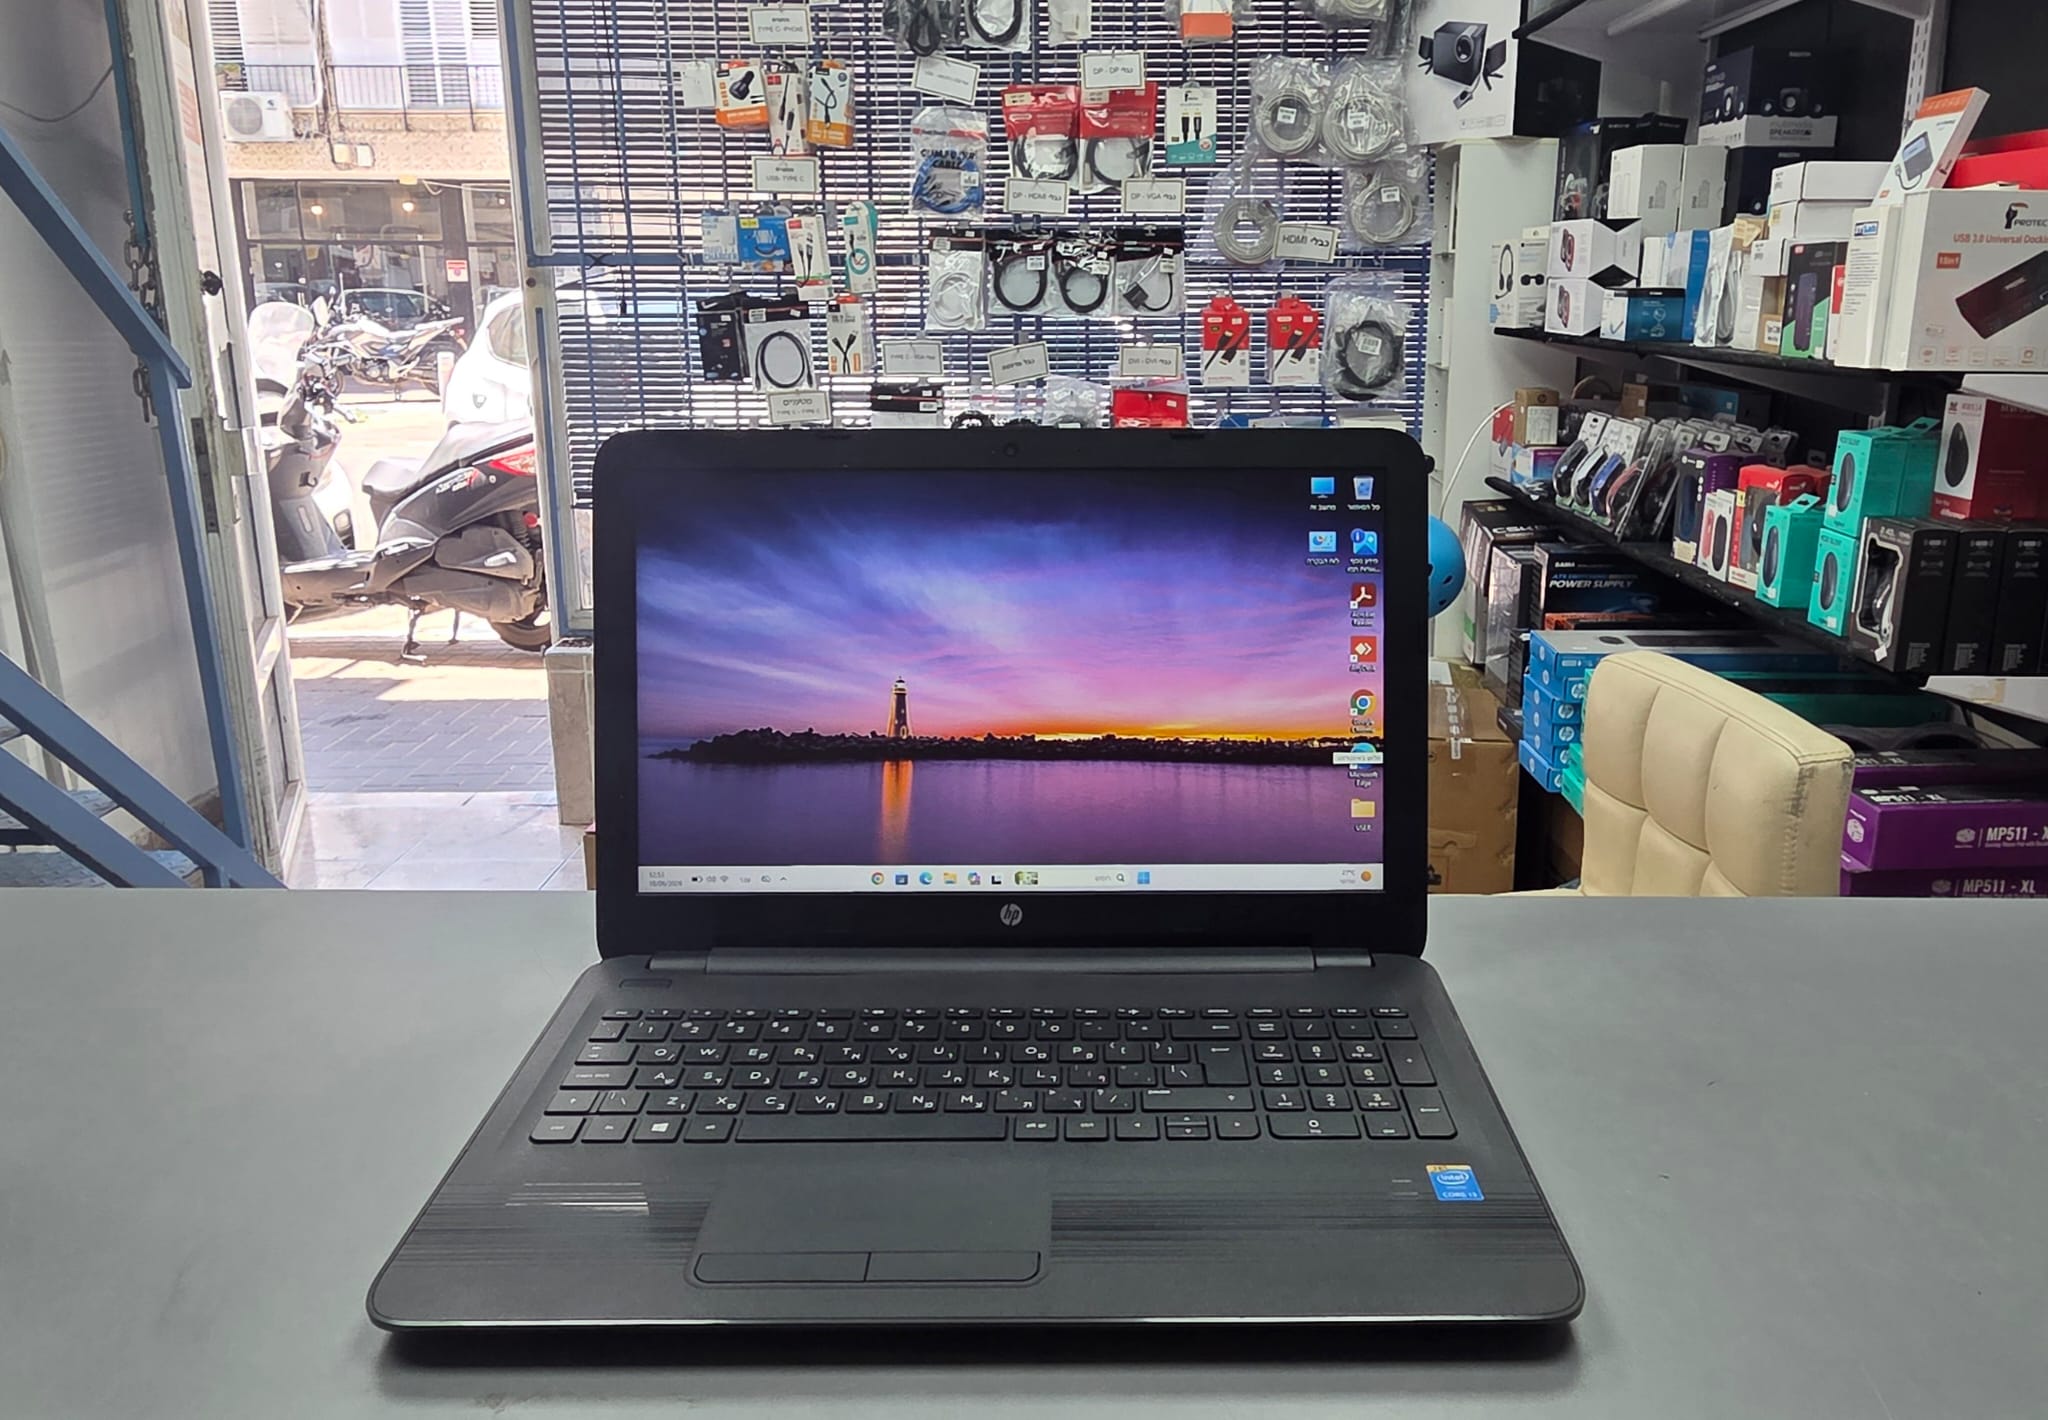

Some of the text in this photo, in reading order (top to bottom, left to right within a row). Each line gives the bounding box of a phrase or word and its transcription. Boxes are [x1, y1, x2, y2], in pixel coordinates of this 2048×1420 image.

[1282, 234, 1309, 245] HDMI
[1953, 233, 1970, 244] USB
[1986, 233, 2022, 244] Universal
[1549, 579, 1633, 589] POWER SUPPLY
[1986, 826, 2028, 841] MP511
[1963, 878, 2006, 893] MP511
[2020, 878, 2036, 894] XL
[1000, 903, 1023, 926] hp
[699, 1048, 717, 1056] W
[793, 1047, 806, 1056] R
[841, 1047, 853, 1056] T
[887, 1046, 899, 1056] Y
[933, 1046, 945, 1055] U
[1072, 1046, 1083, 1055] P
[702, 1071, 714, 1080] S
[749, 1071, 762, 1080] D
[797, 1070, 809, 1080] F
[892, 1070, 905, 1079] H
[942, 1069, 952, 1079] J
[988, 1069, 1000, 1079] K
[1036, 1069, 1047, 1079] L
[814, 1095, 828, 1105] V
[912, 1095, 925, 1104] N
[960, 1094, 974, 1104] M
